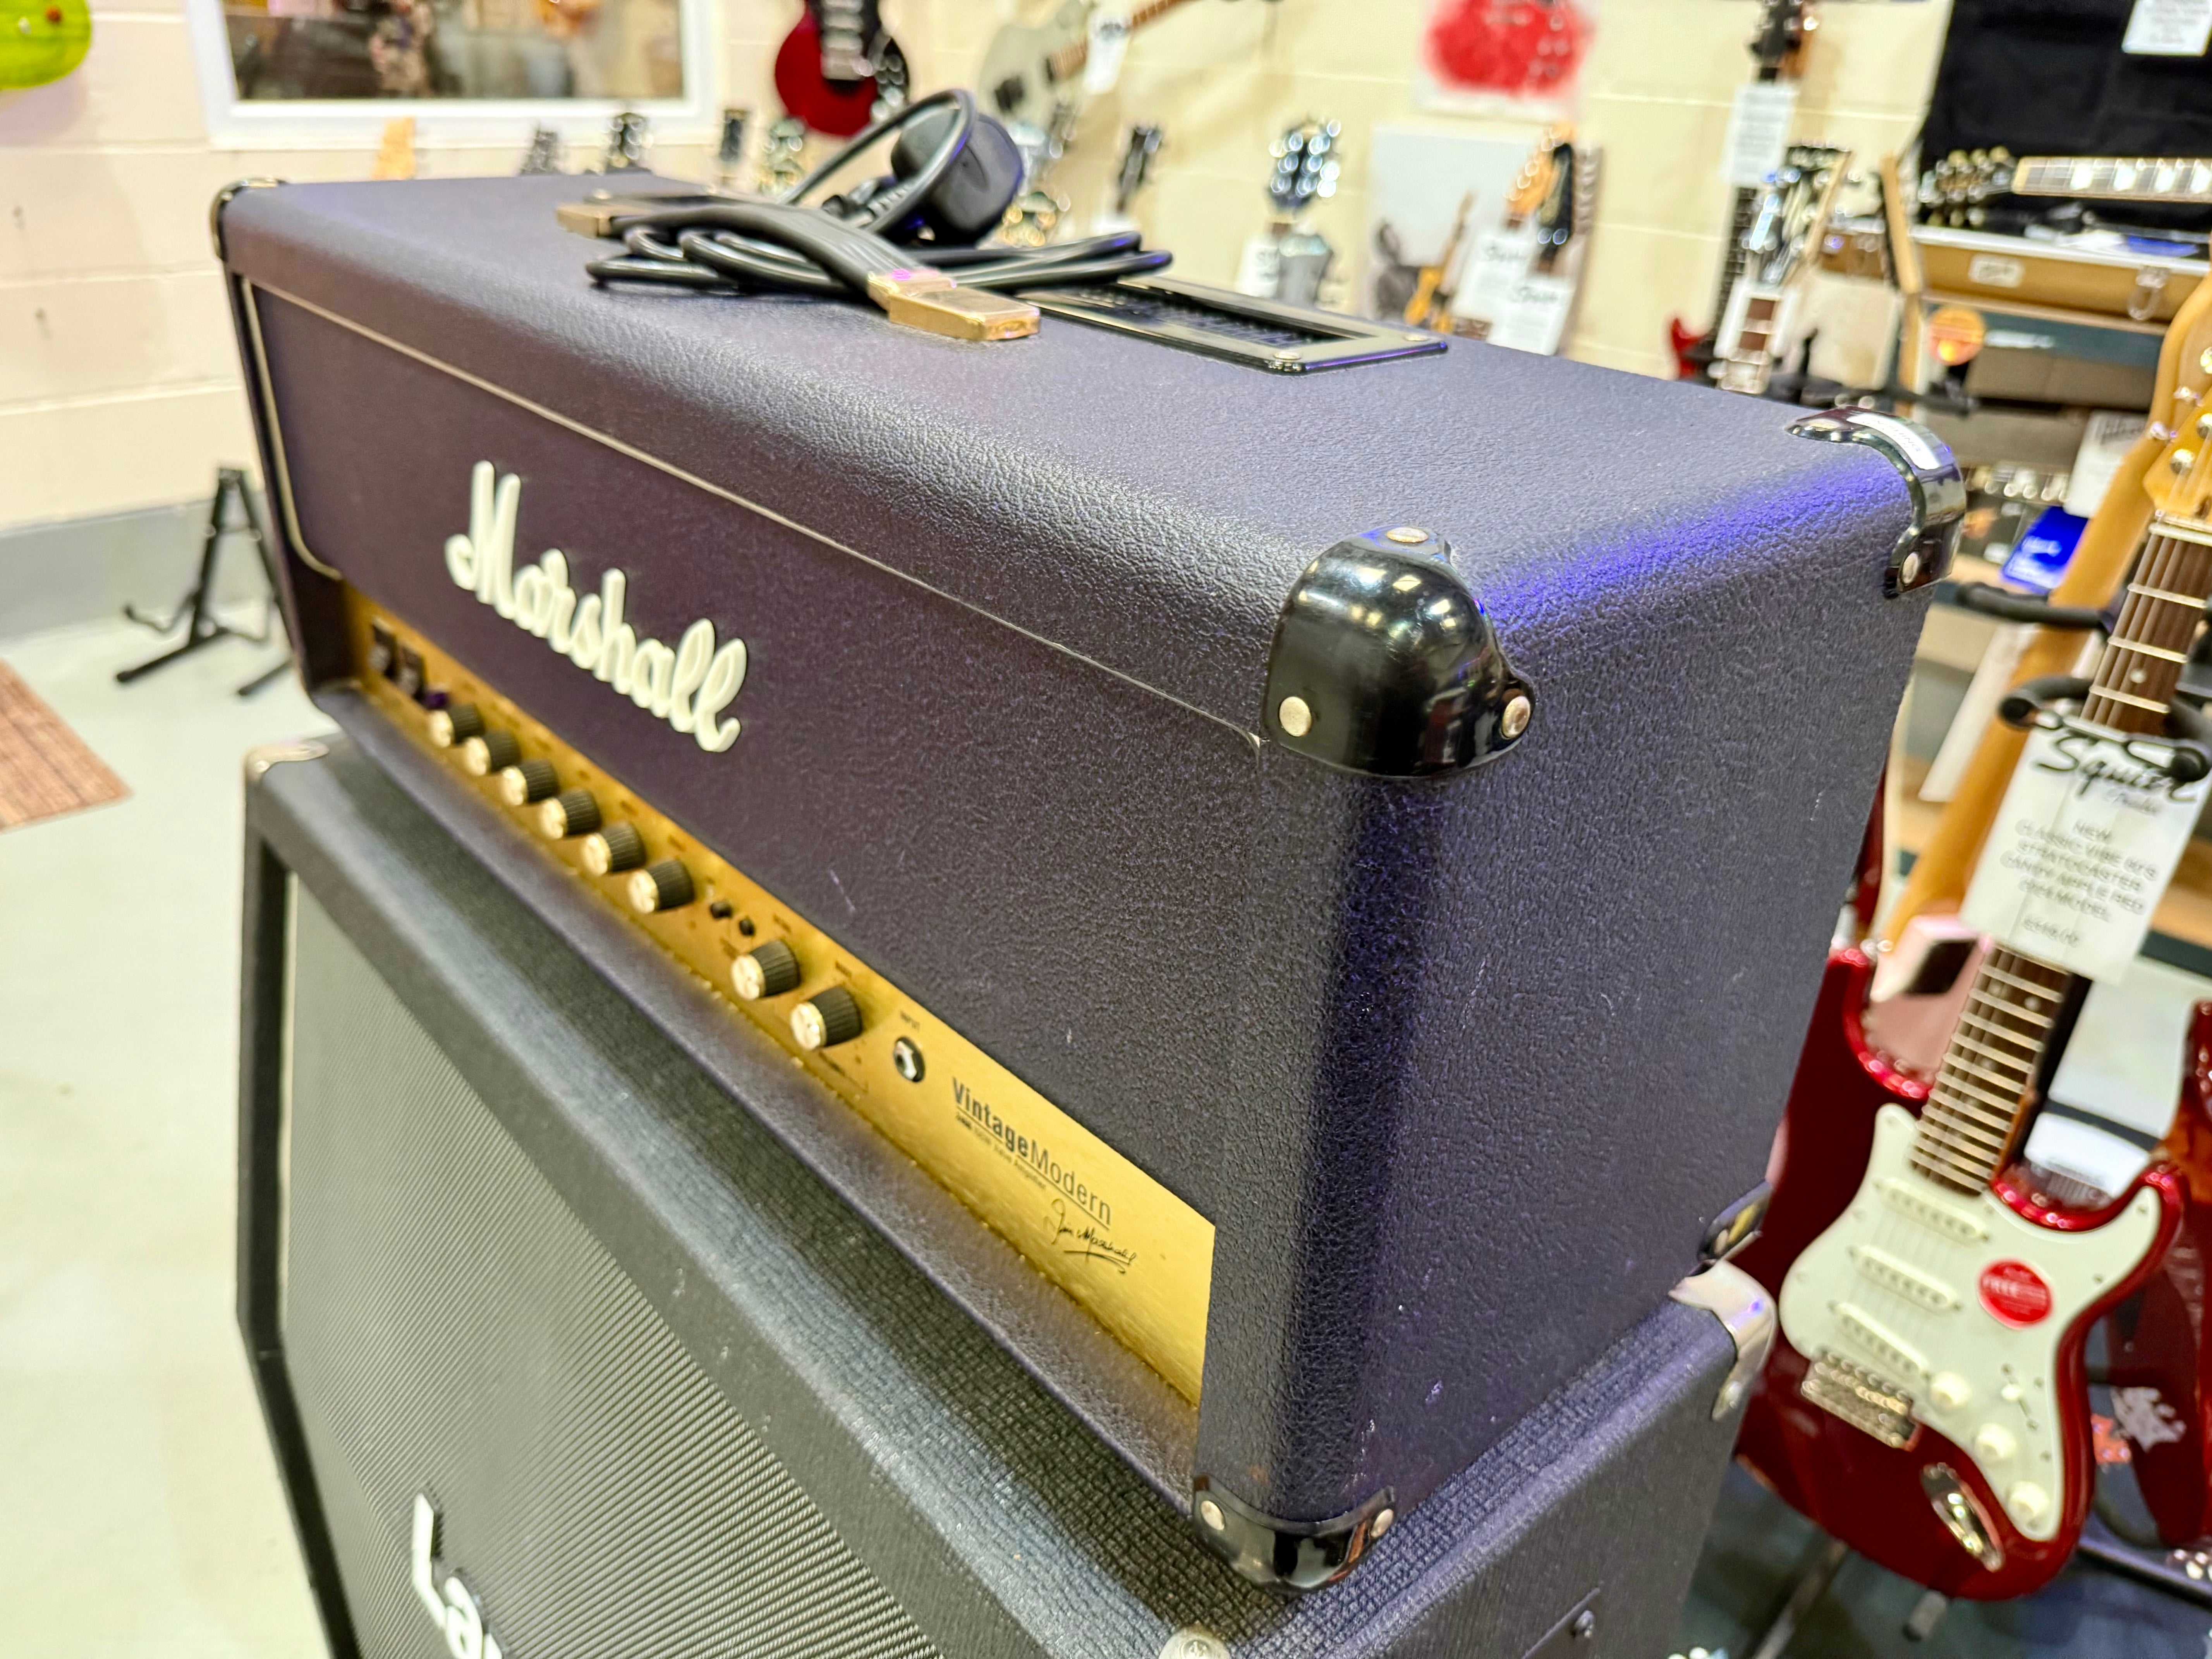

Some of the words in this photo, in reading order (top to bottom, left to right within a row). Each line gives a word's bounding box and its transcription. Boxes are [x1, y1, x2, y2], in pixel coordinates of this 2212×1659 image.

[445, 460, 747, 752] Marshall
[2016, 840, 2145, 891] STRATOCASTER
[2073, 820, 2112, 843] NEW
[952, 1076, 1111, 1226] VintageModern
[412, 1493, 503, 1659] La
